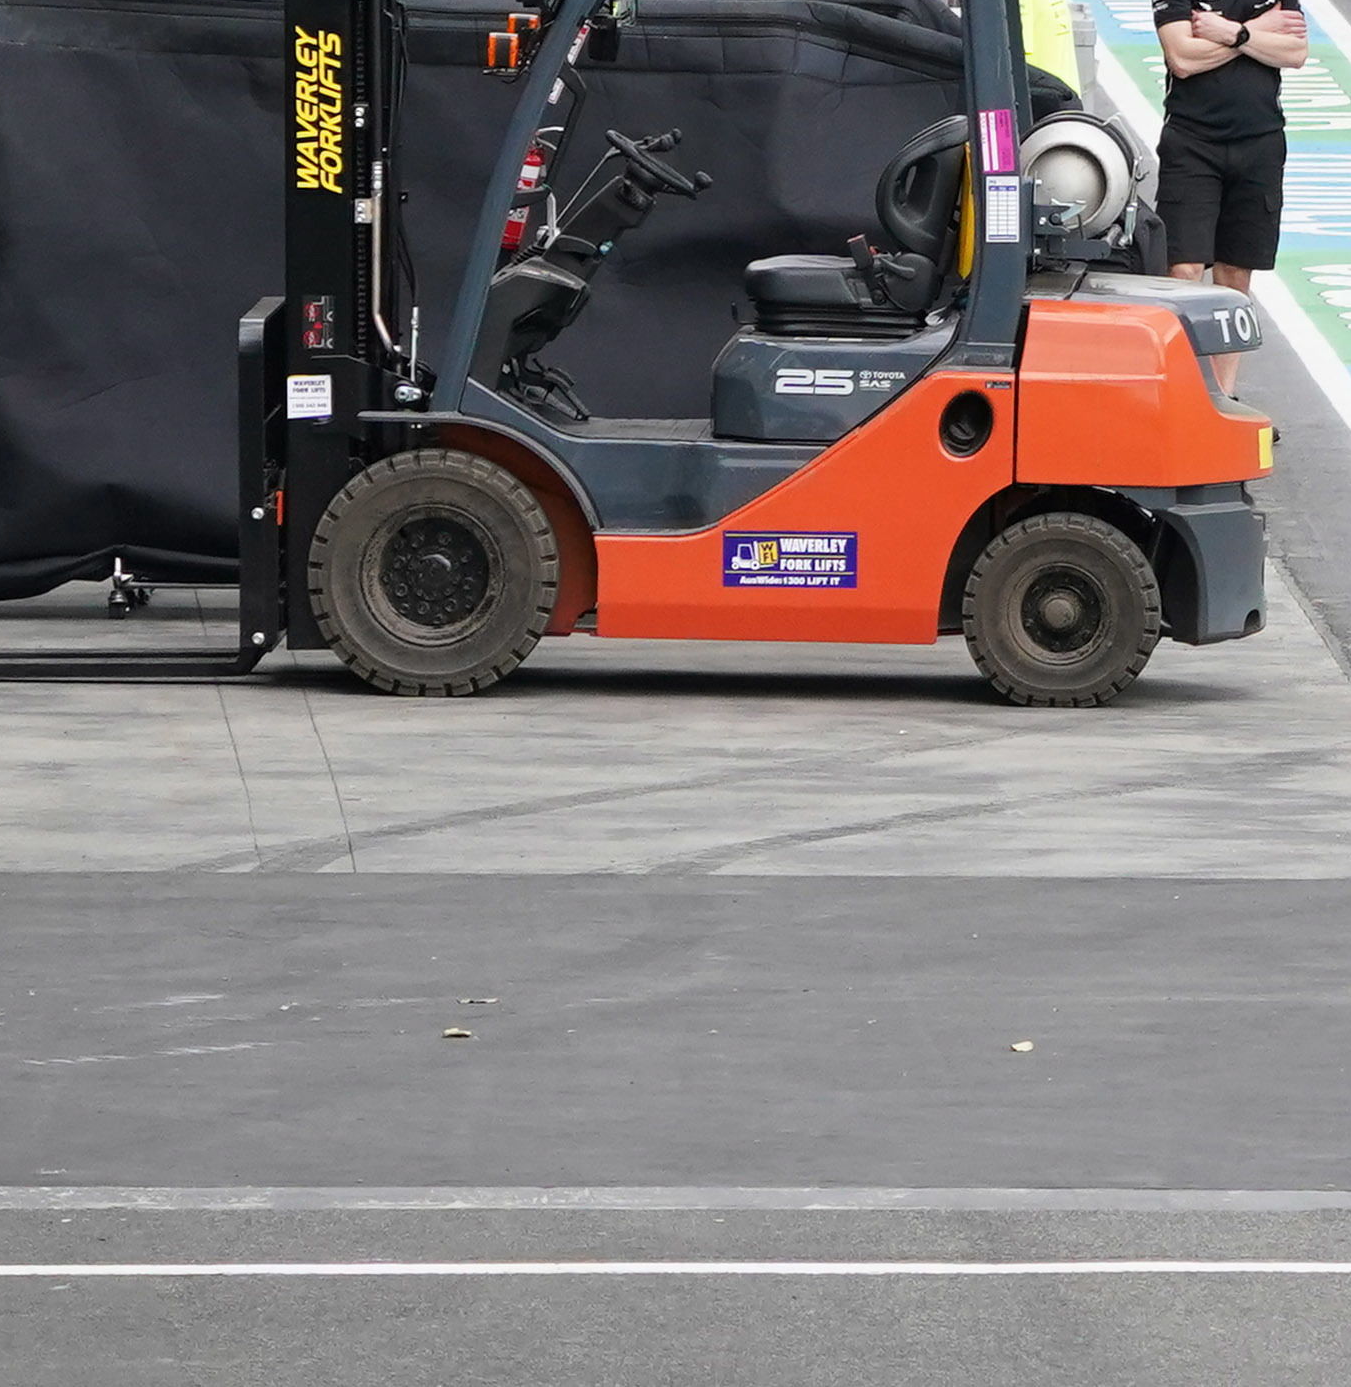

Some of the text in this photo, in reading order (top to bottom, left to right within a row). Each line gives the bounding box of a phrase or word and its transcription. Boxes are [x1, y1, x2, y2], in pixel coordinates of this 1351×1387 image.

[295, 25, 320, 189] WAVERLEY
[318, 30, 343, 194] FORKLIFTS
[775, 368, 855, 396] 25
[873, 371, 906, 380] TOYOTA
[779, 538, 847, 553] WAVERLEY
[779, 558, 846, 572] FORK LIFTS
[807, 577, 829, 586] LIFT
[830, 577, 841, 586] IT
